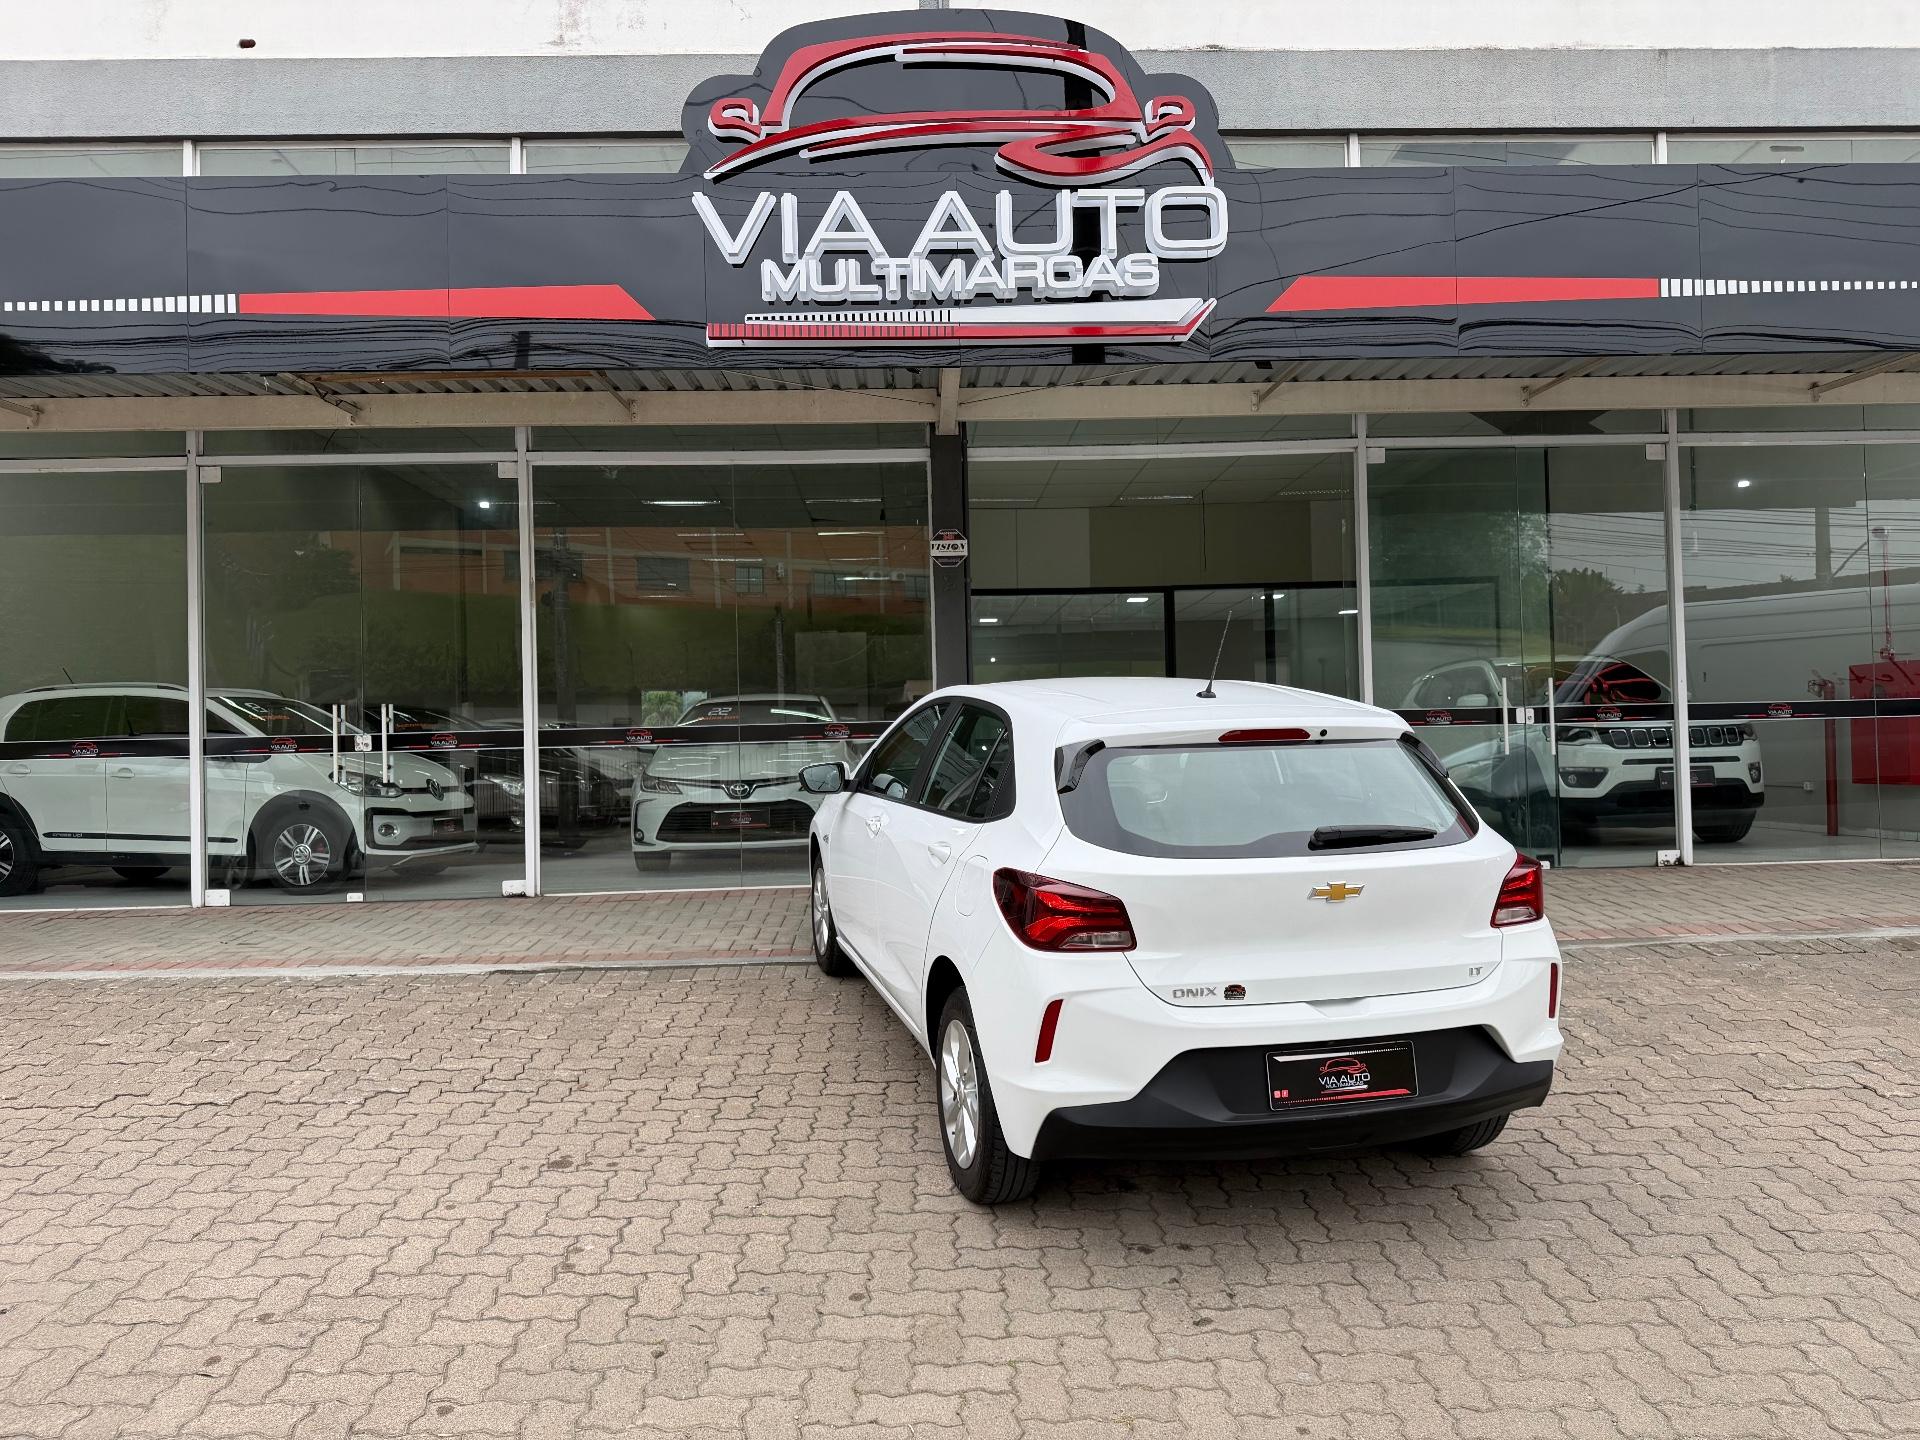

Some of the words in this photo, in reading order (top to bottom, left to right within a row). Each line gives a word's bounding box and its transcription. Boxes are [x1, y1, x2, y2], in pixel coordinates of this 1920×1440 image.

[692, 190, 890, 264] VIA
[906, 186, 1228, 262] AUTO
[761, 252, 1159, 302] MULTIMARCAS
[931, 543, 966, 551] VISION
[1469, 966, 1484, 977] LT
[1172, 986, 1217, 999] ONIX
[1319, 1075, 1338, 1085] VIA
[1340, 1072, 1370, 1083] AUTO
